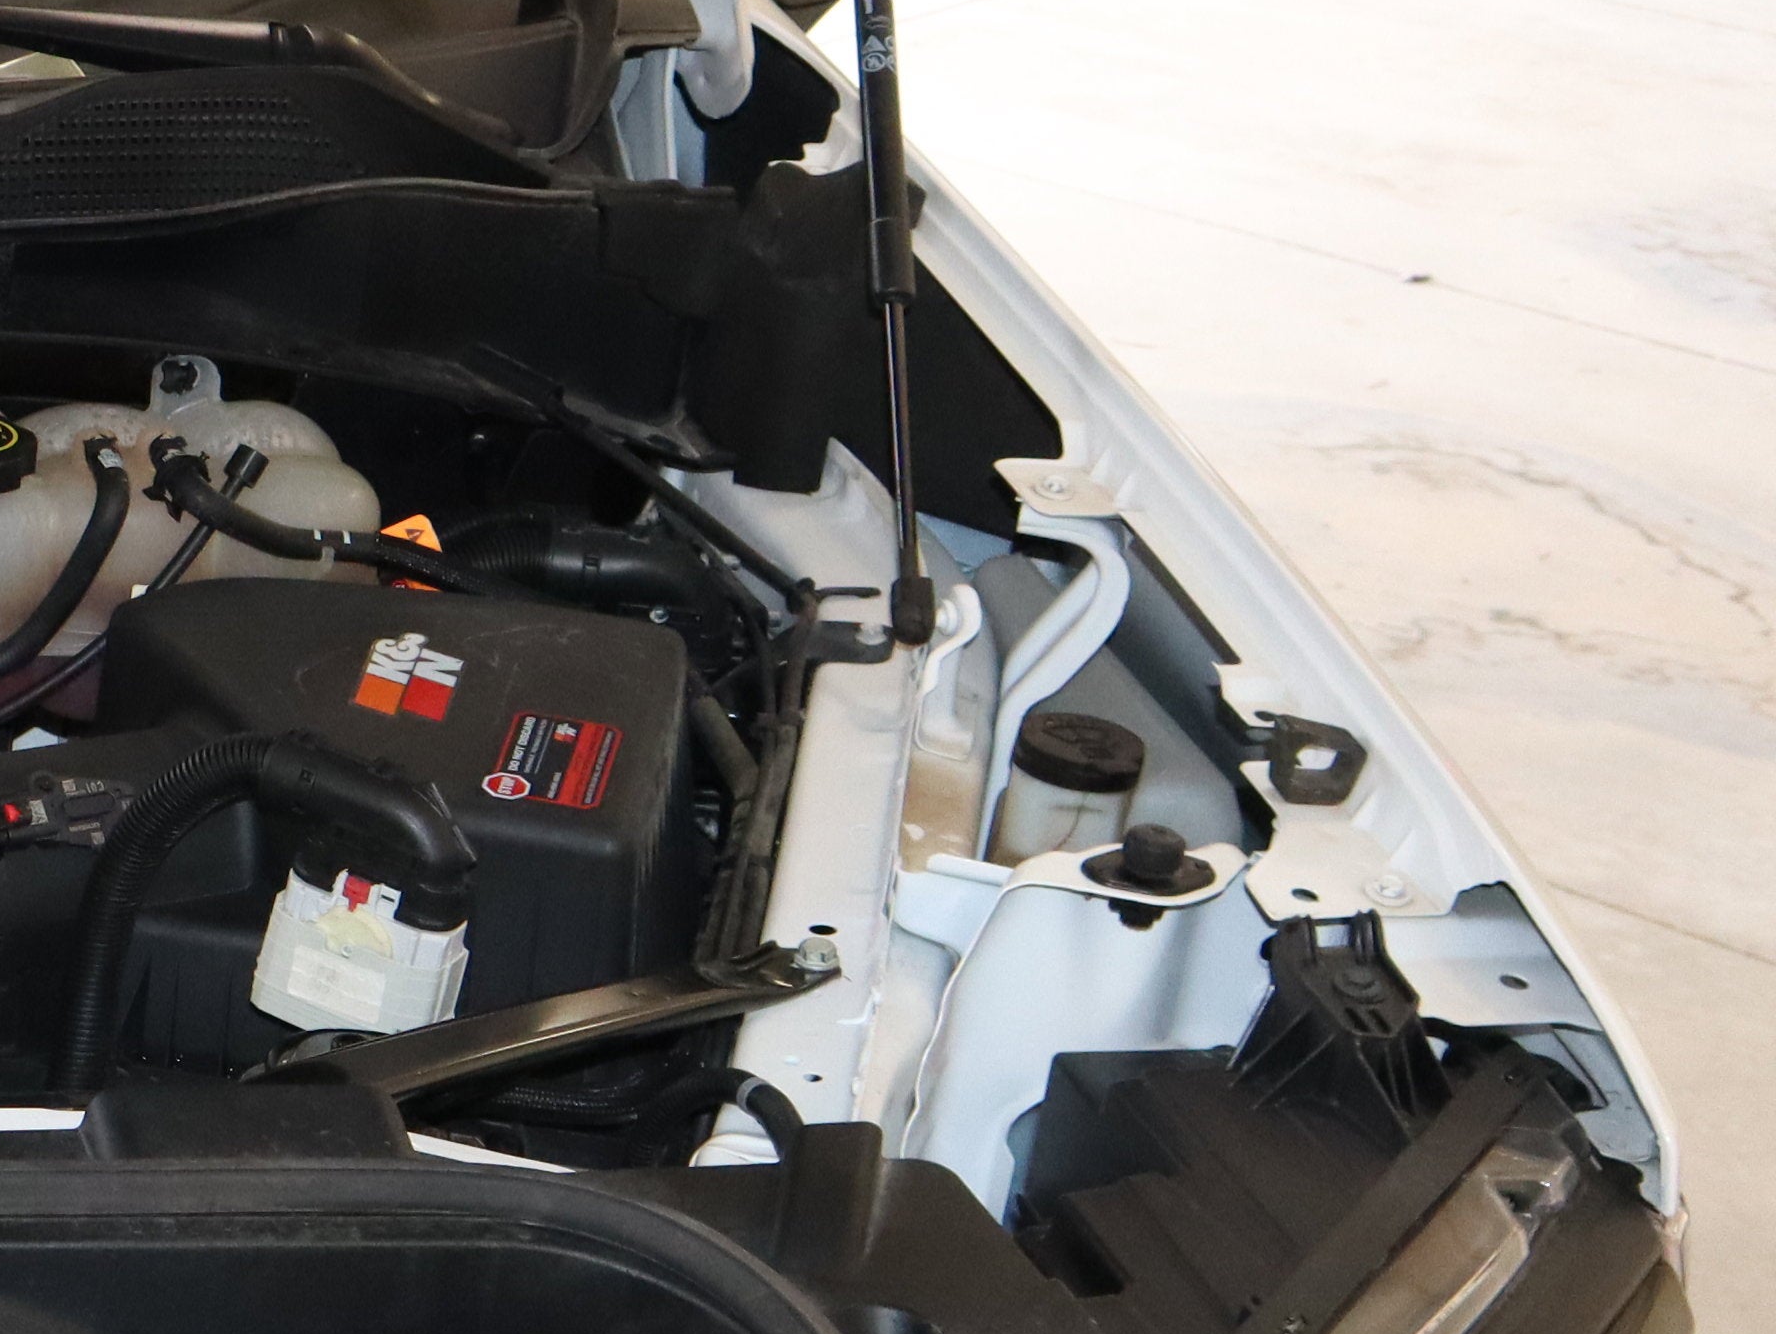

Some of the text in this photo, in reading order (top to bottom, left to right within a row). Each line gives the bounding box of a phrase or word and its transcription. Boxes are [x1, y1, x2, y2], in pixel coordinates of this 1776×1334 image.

[366, 632, 464, 689] K&N
[516, 717, 537, 746] DISCARD
[511, 745, 526, 759] NOT
[506, 760, 521, 771] DO
[497, 775, 517, 795] STOP
